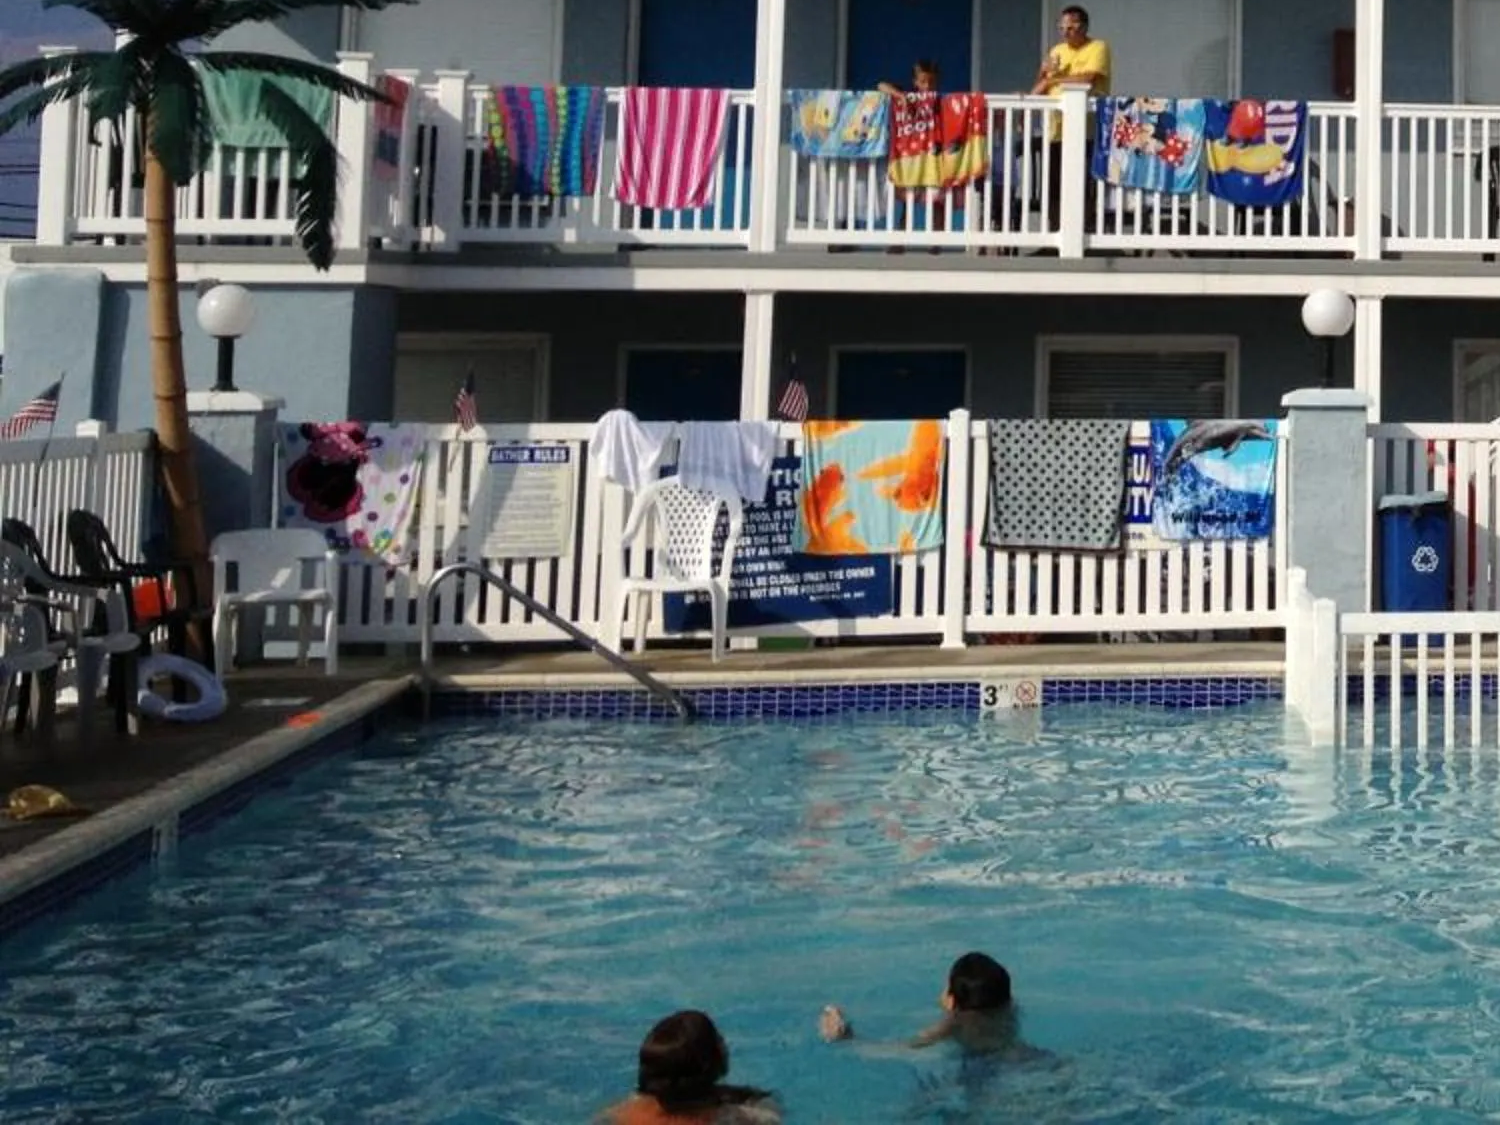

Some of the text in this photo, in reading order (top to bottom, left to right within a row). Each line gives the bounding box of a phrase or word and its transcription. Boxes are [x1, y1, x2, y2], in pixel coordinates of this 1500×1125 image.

[491, 449, 567, 462] BATHER RULES
[745, 523, 757, 535] TO
[746, 562, 766, 573] OWN
[829, 570, 844, 581] THE
[845, 567, 876, 580] OWNER
[749, 588, 767, 600] NOT
[783, 585, 799, 596] THE
[984, 685, 997, 706] 3
